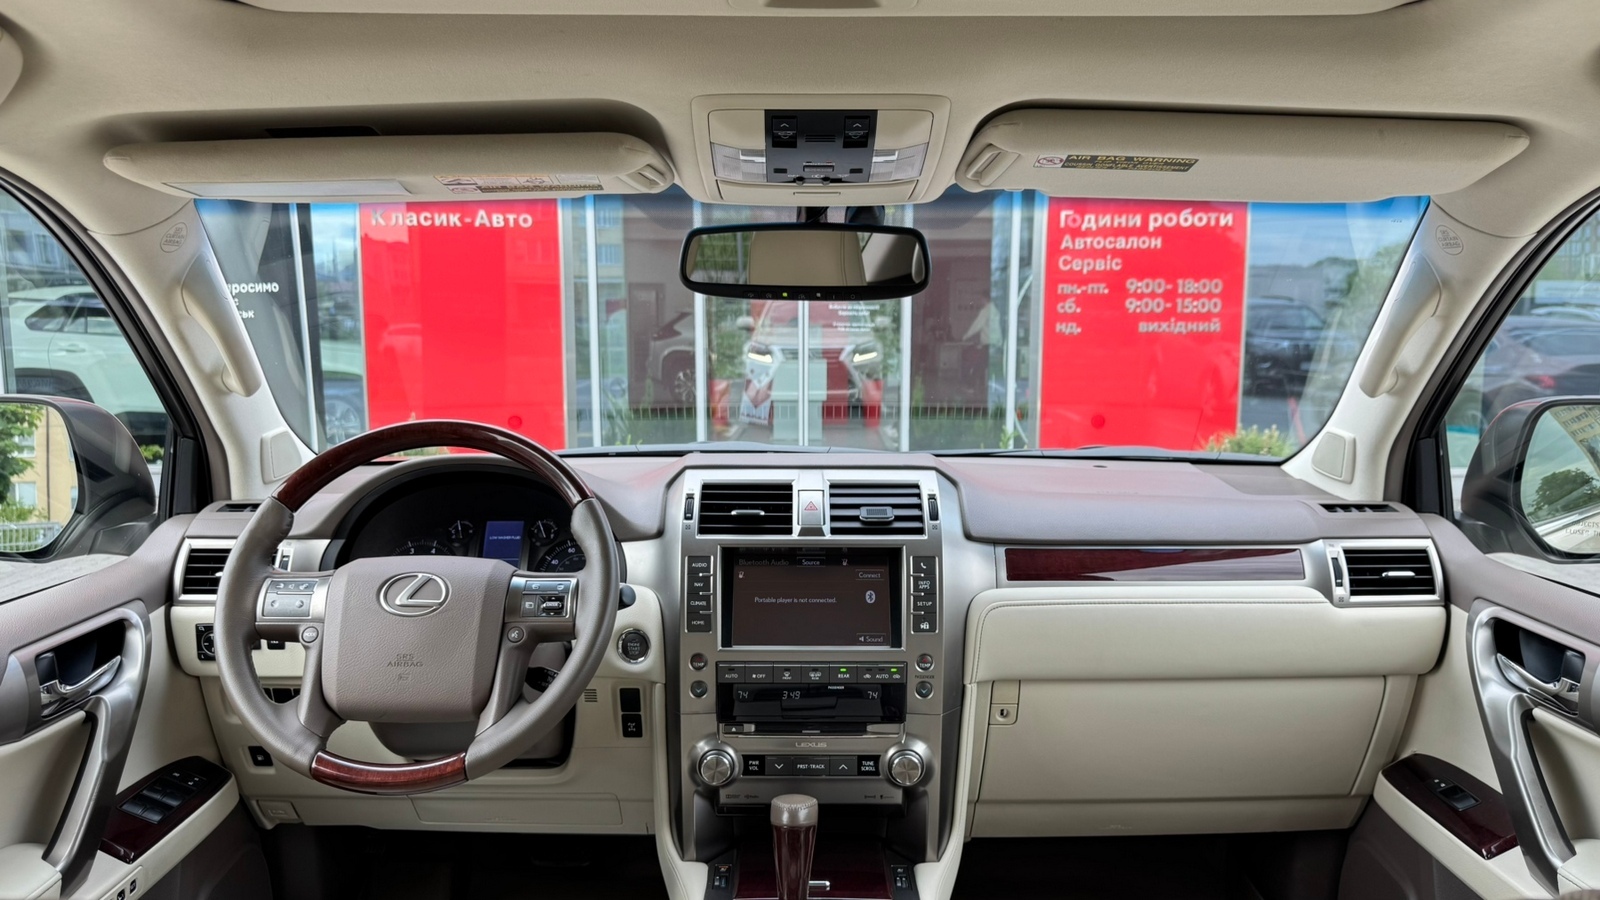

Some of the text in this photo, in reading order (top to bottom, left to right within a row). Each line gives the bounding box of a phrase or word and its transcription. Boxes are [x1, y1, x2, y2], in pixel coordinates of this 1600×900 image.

[1059, 208, 1234, 231] Години роботи
[1060, 234, 1162, 251] Автосалон
[1058, 255, 1122, 274] Сервіс
[1057, 297, 1081, 313] сб.
[1055, 318, 1221, 335] нд. вихідний
[802, 558, 821, 566] Source
[737, 690, 749, 699] 74
[867, 691, 879, 699] 74
